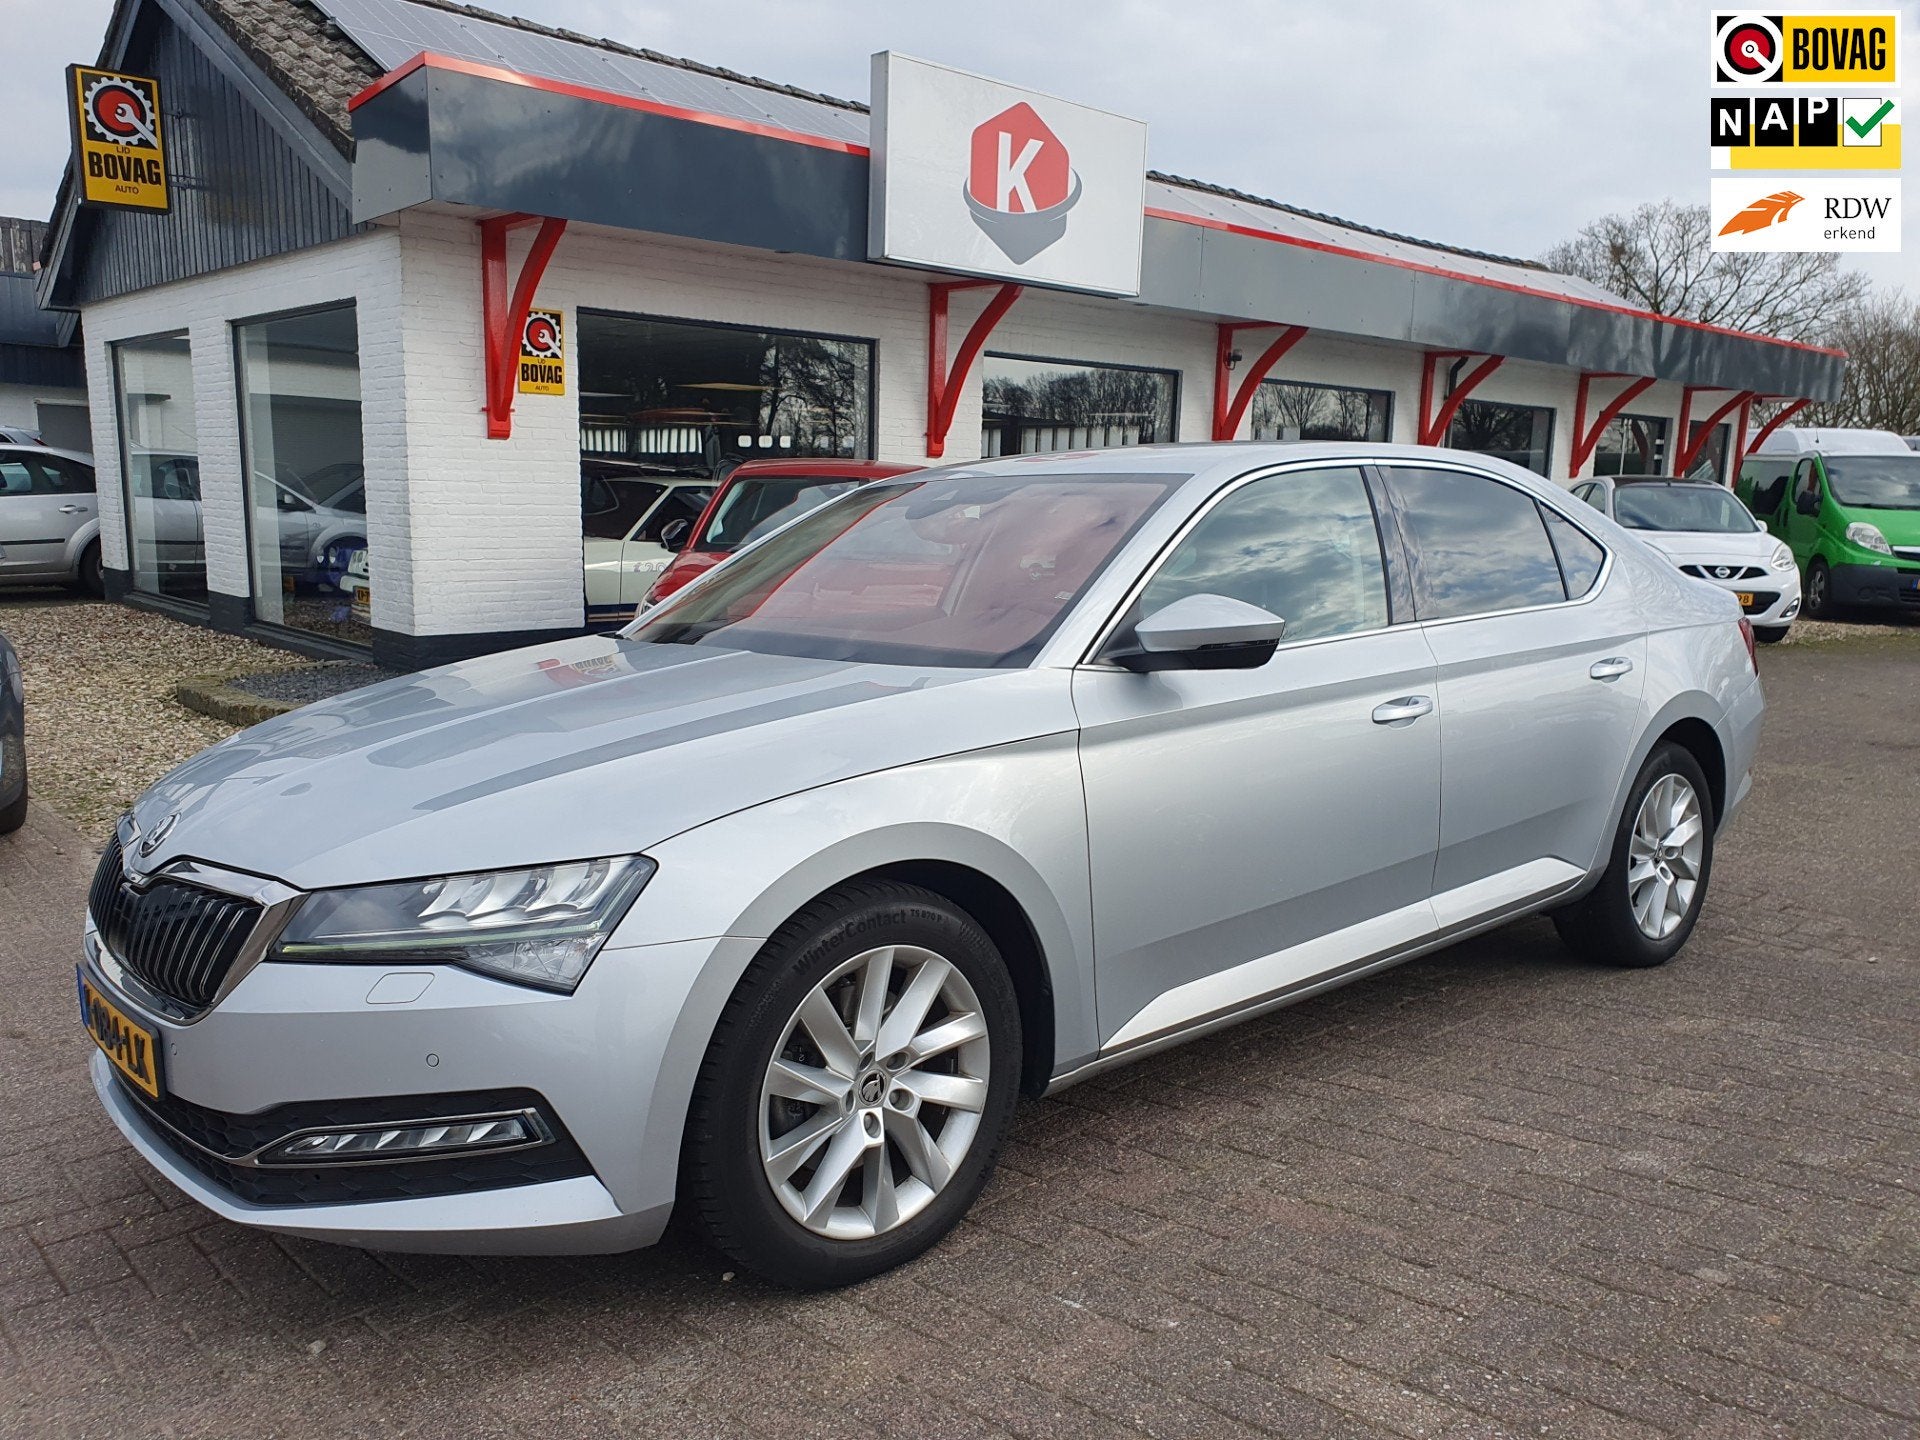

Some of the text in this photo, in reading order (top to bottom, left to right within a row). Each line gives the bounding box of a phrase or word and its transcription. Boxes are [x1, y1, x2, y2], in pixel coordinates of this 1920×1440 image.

[115, 145, 130, 155] LID
[87, 150, 162, 186] BOVAG
[996, 130, 1045, 213] K
[115, 184, 139, 195] AUTO
[521, 363, 563, 384] BOVAG
[791, 909, 906, 976] WinterContact
